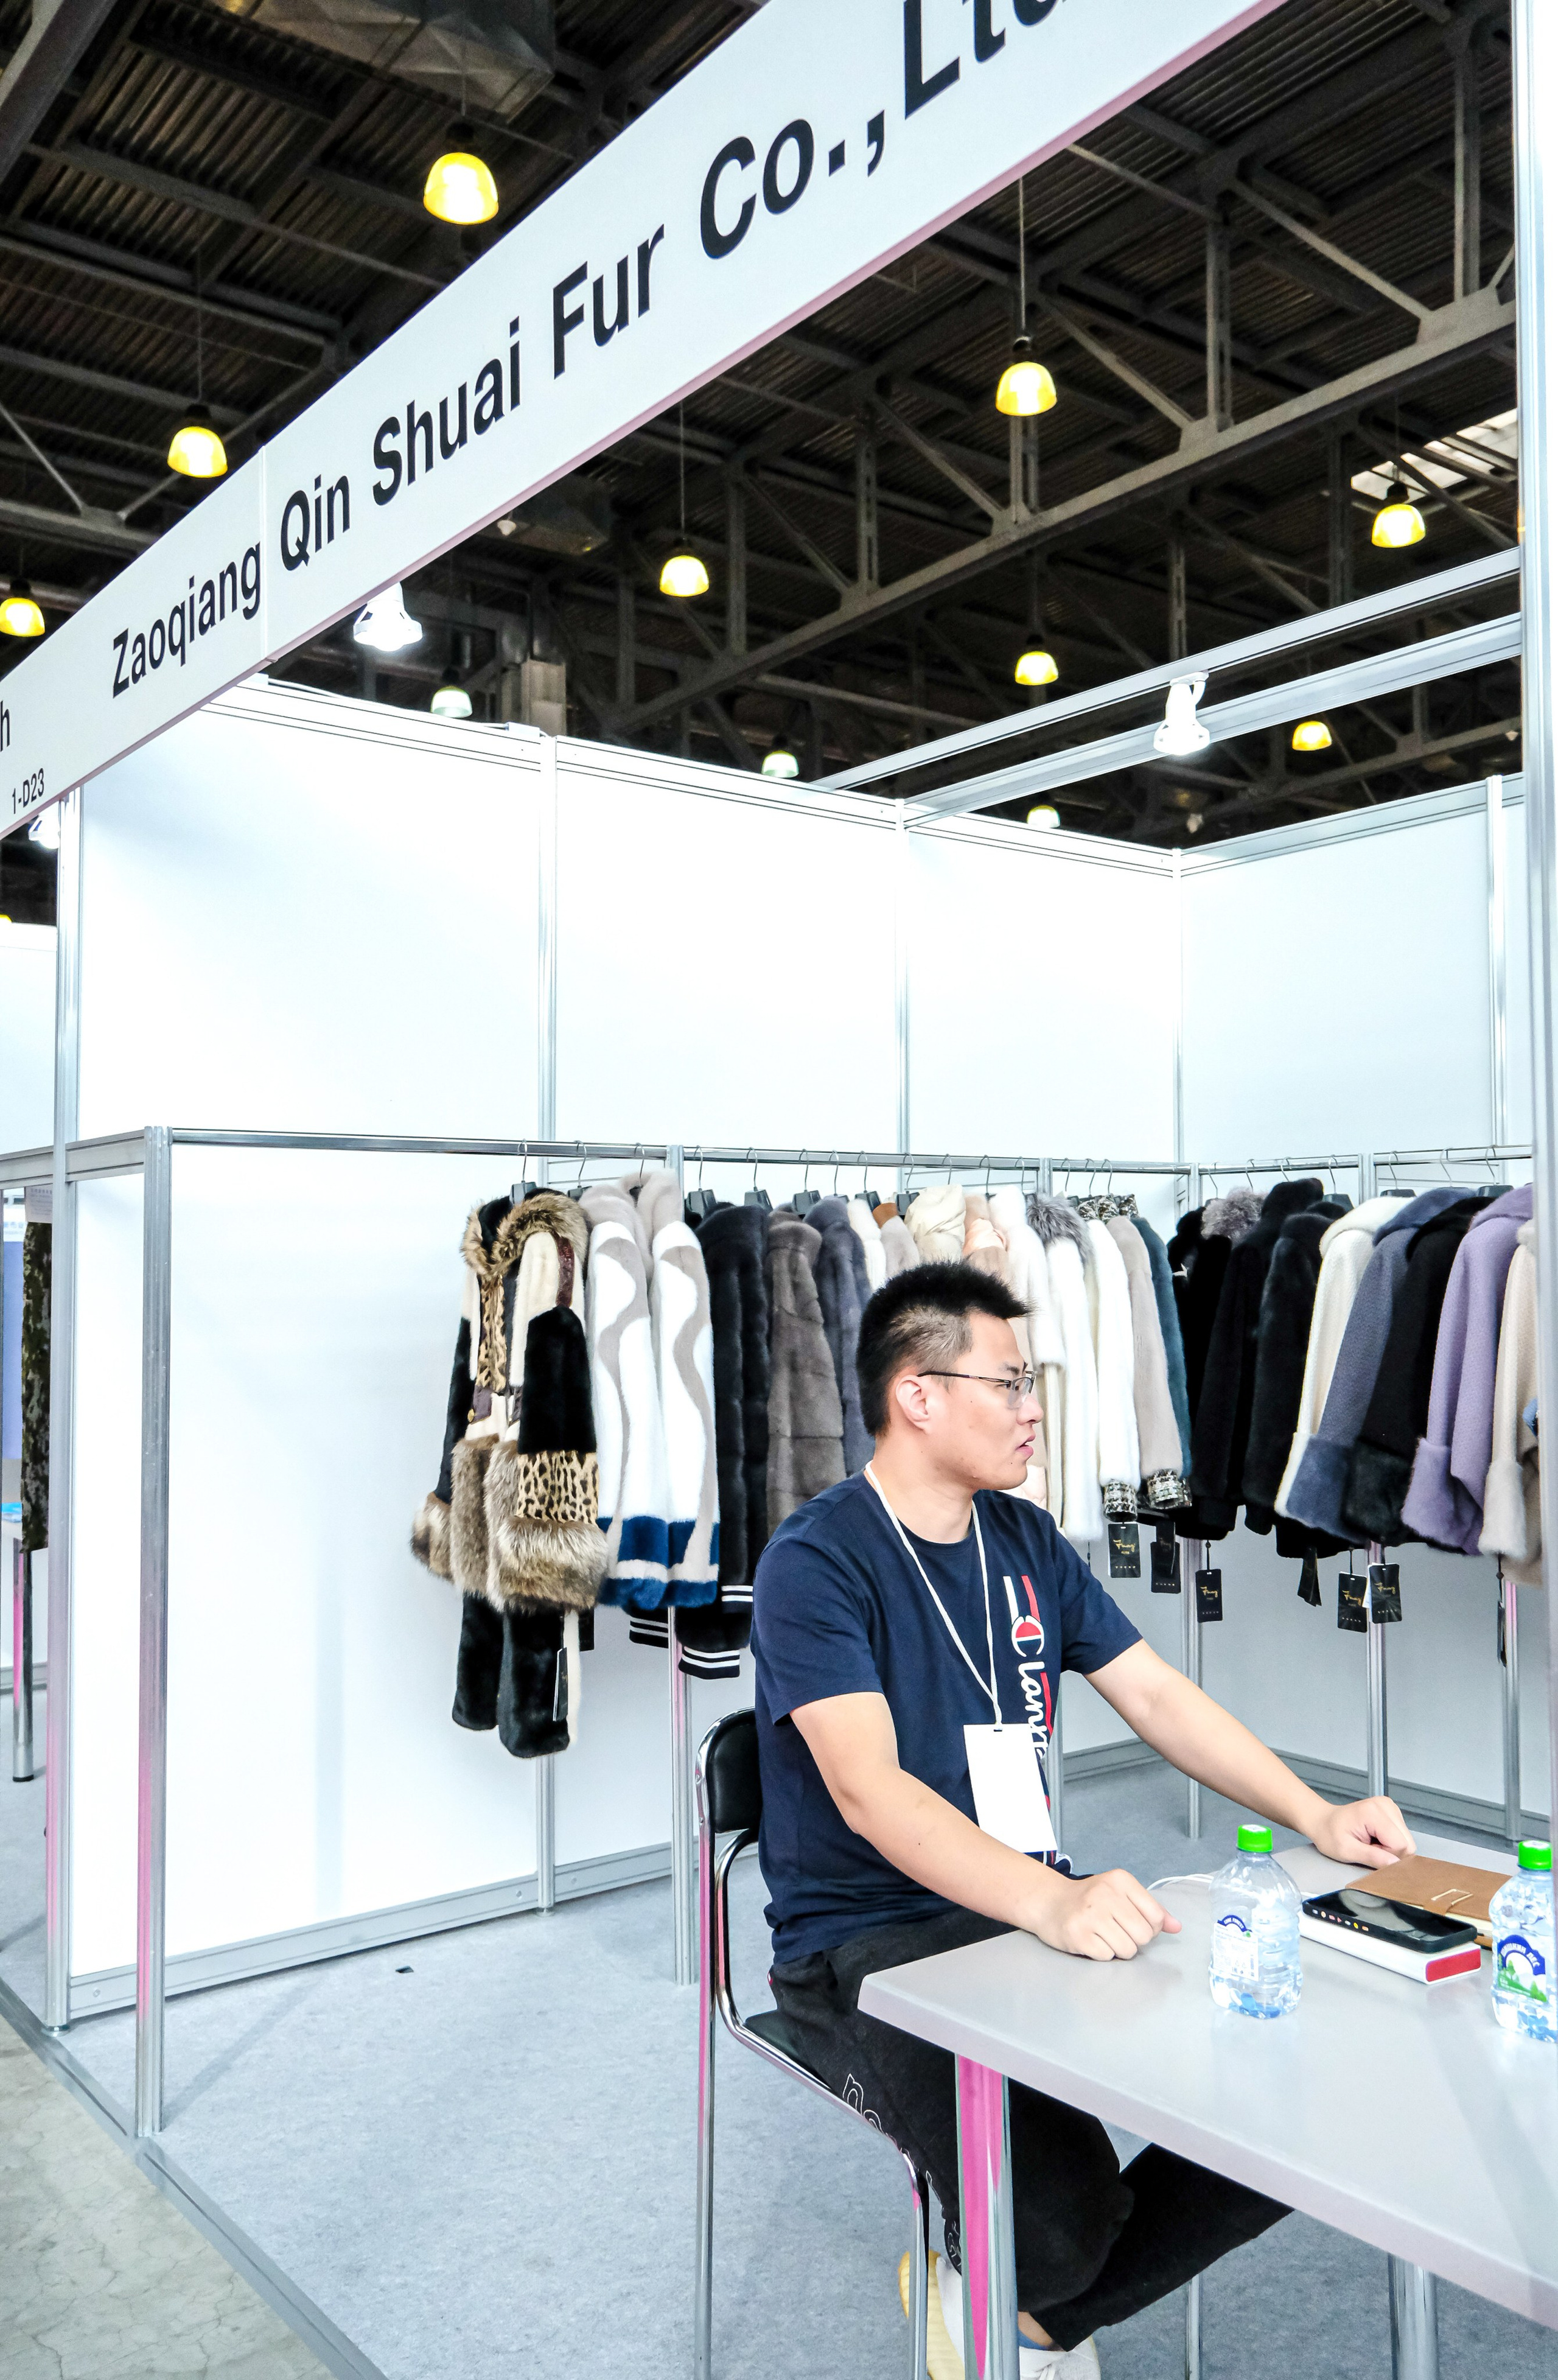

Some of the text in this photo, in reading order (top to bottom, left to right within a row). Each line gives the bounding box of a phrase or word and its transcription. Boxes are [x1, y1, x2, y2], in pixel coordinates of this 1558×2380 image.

[113, 541, 261, 699] Zaoqiang
[280, 474, 350, 571] Qin
[372, 316, 521, 506] Shuai
[553, 223, 665, 380] Fur
[12, 768, 44, 814] 1-D23
